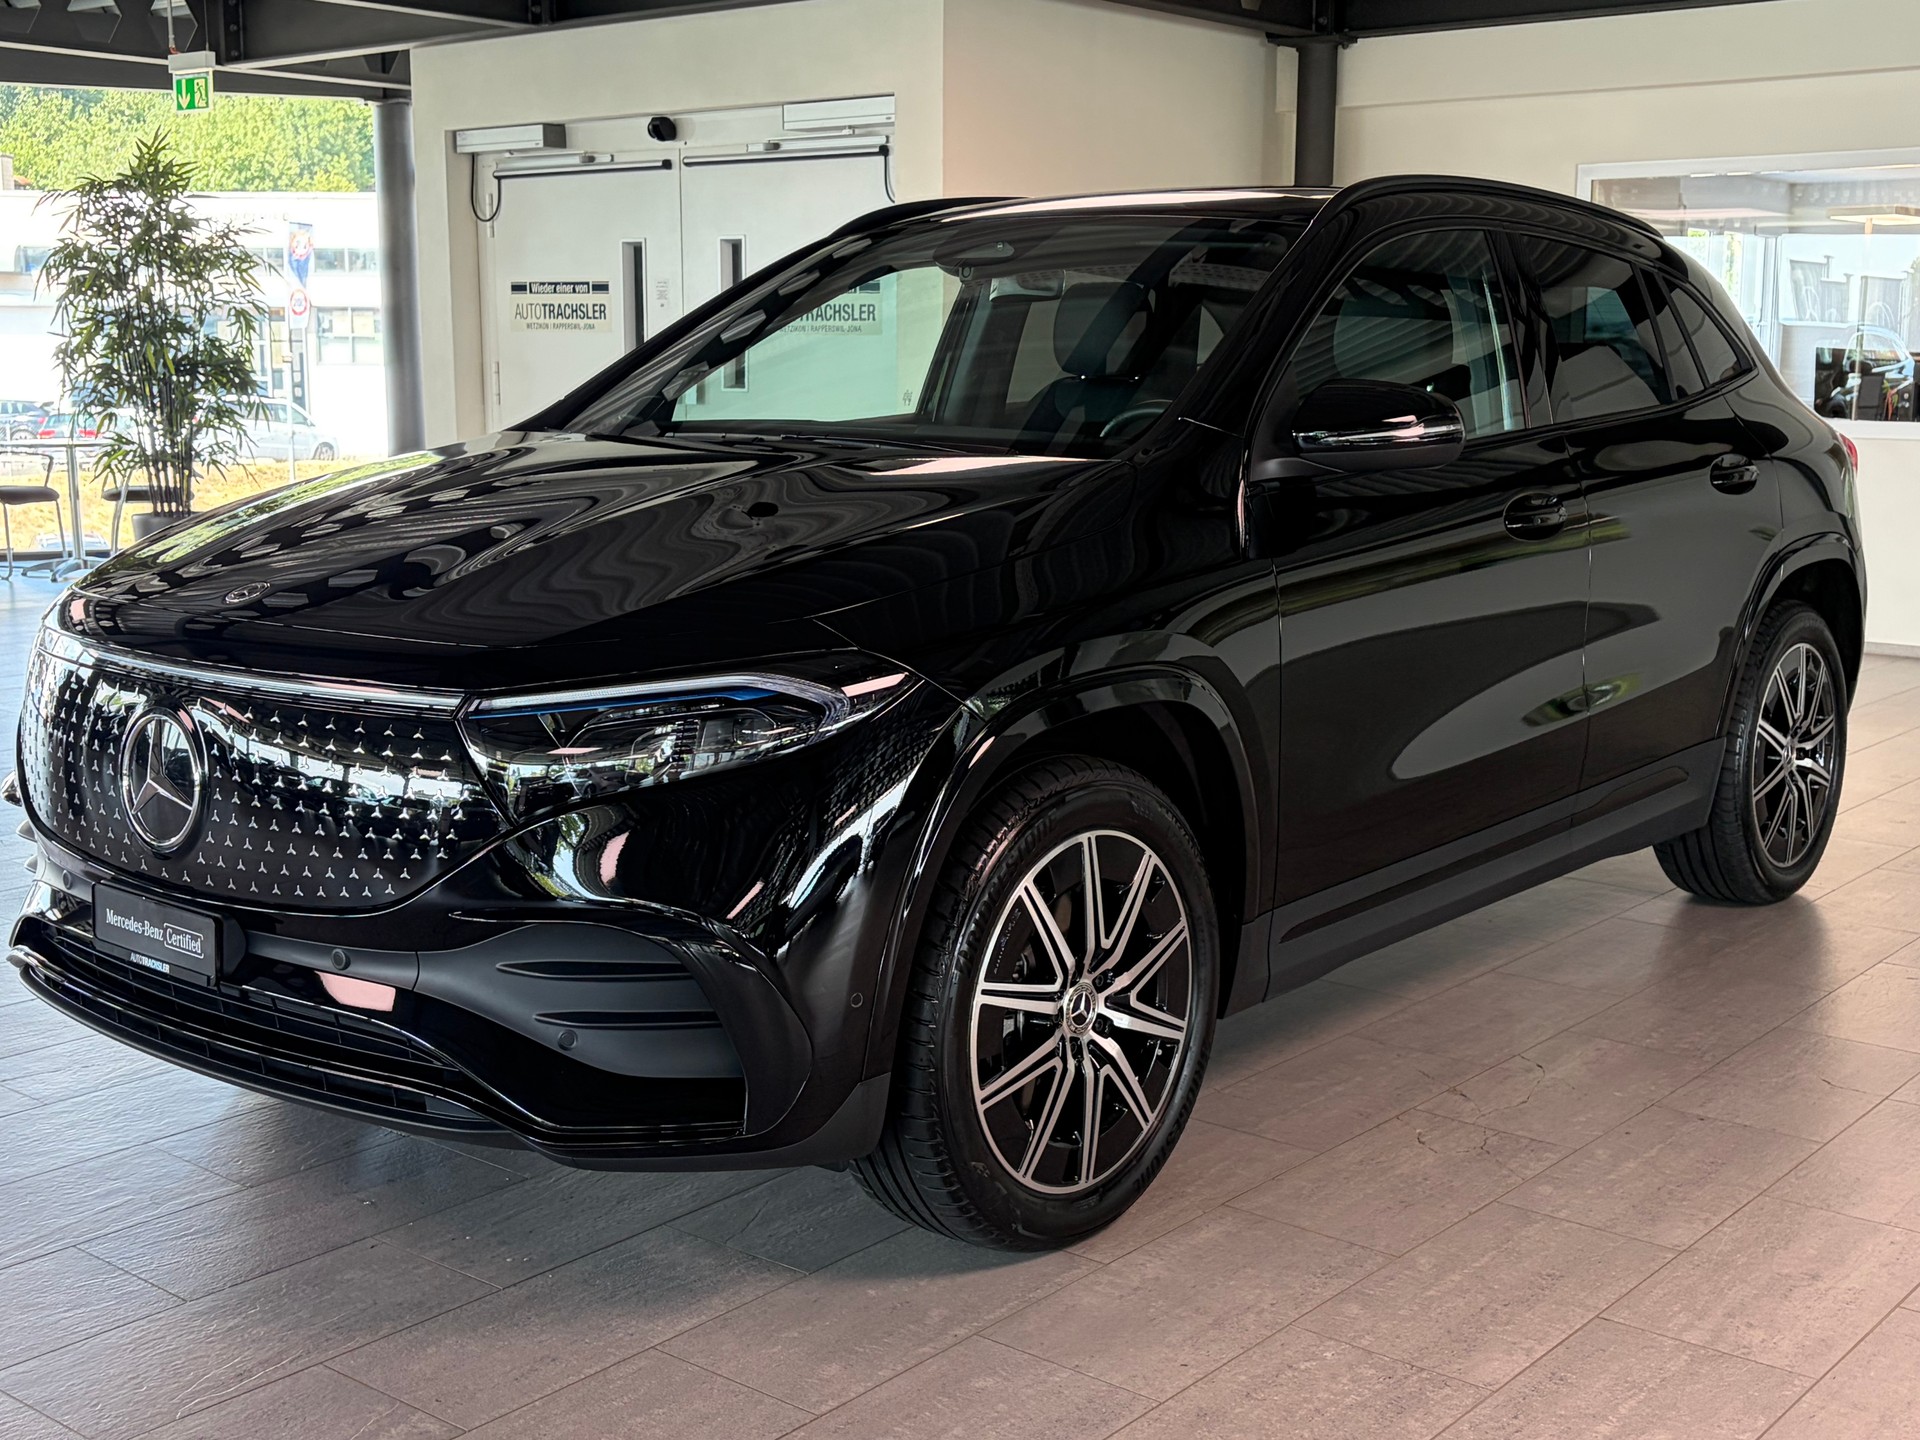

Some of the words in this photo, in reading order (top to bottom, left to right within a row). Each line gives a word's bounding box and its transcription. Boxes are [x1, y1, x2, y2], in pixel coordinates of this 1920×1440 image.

[531, 282, 555, 294] Wieder
[556, 283, 573, 294] einer
[576, 283, 588, 294] von
[514, 302, 607, 320] AUTOTRACHSLER
[799, 303, 876, 322] RACHSLER
[105, 908, 164, 941] Mercedes-Benz
[166, 928, 201, 953] Certified
